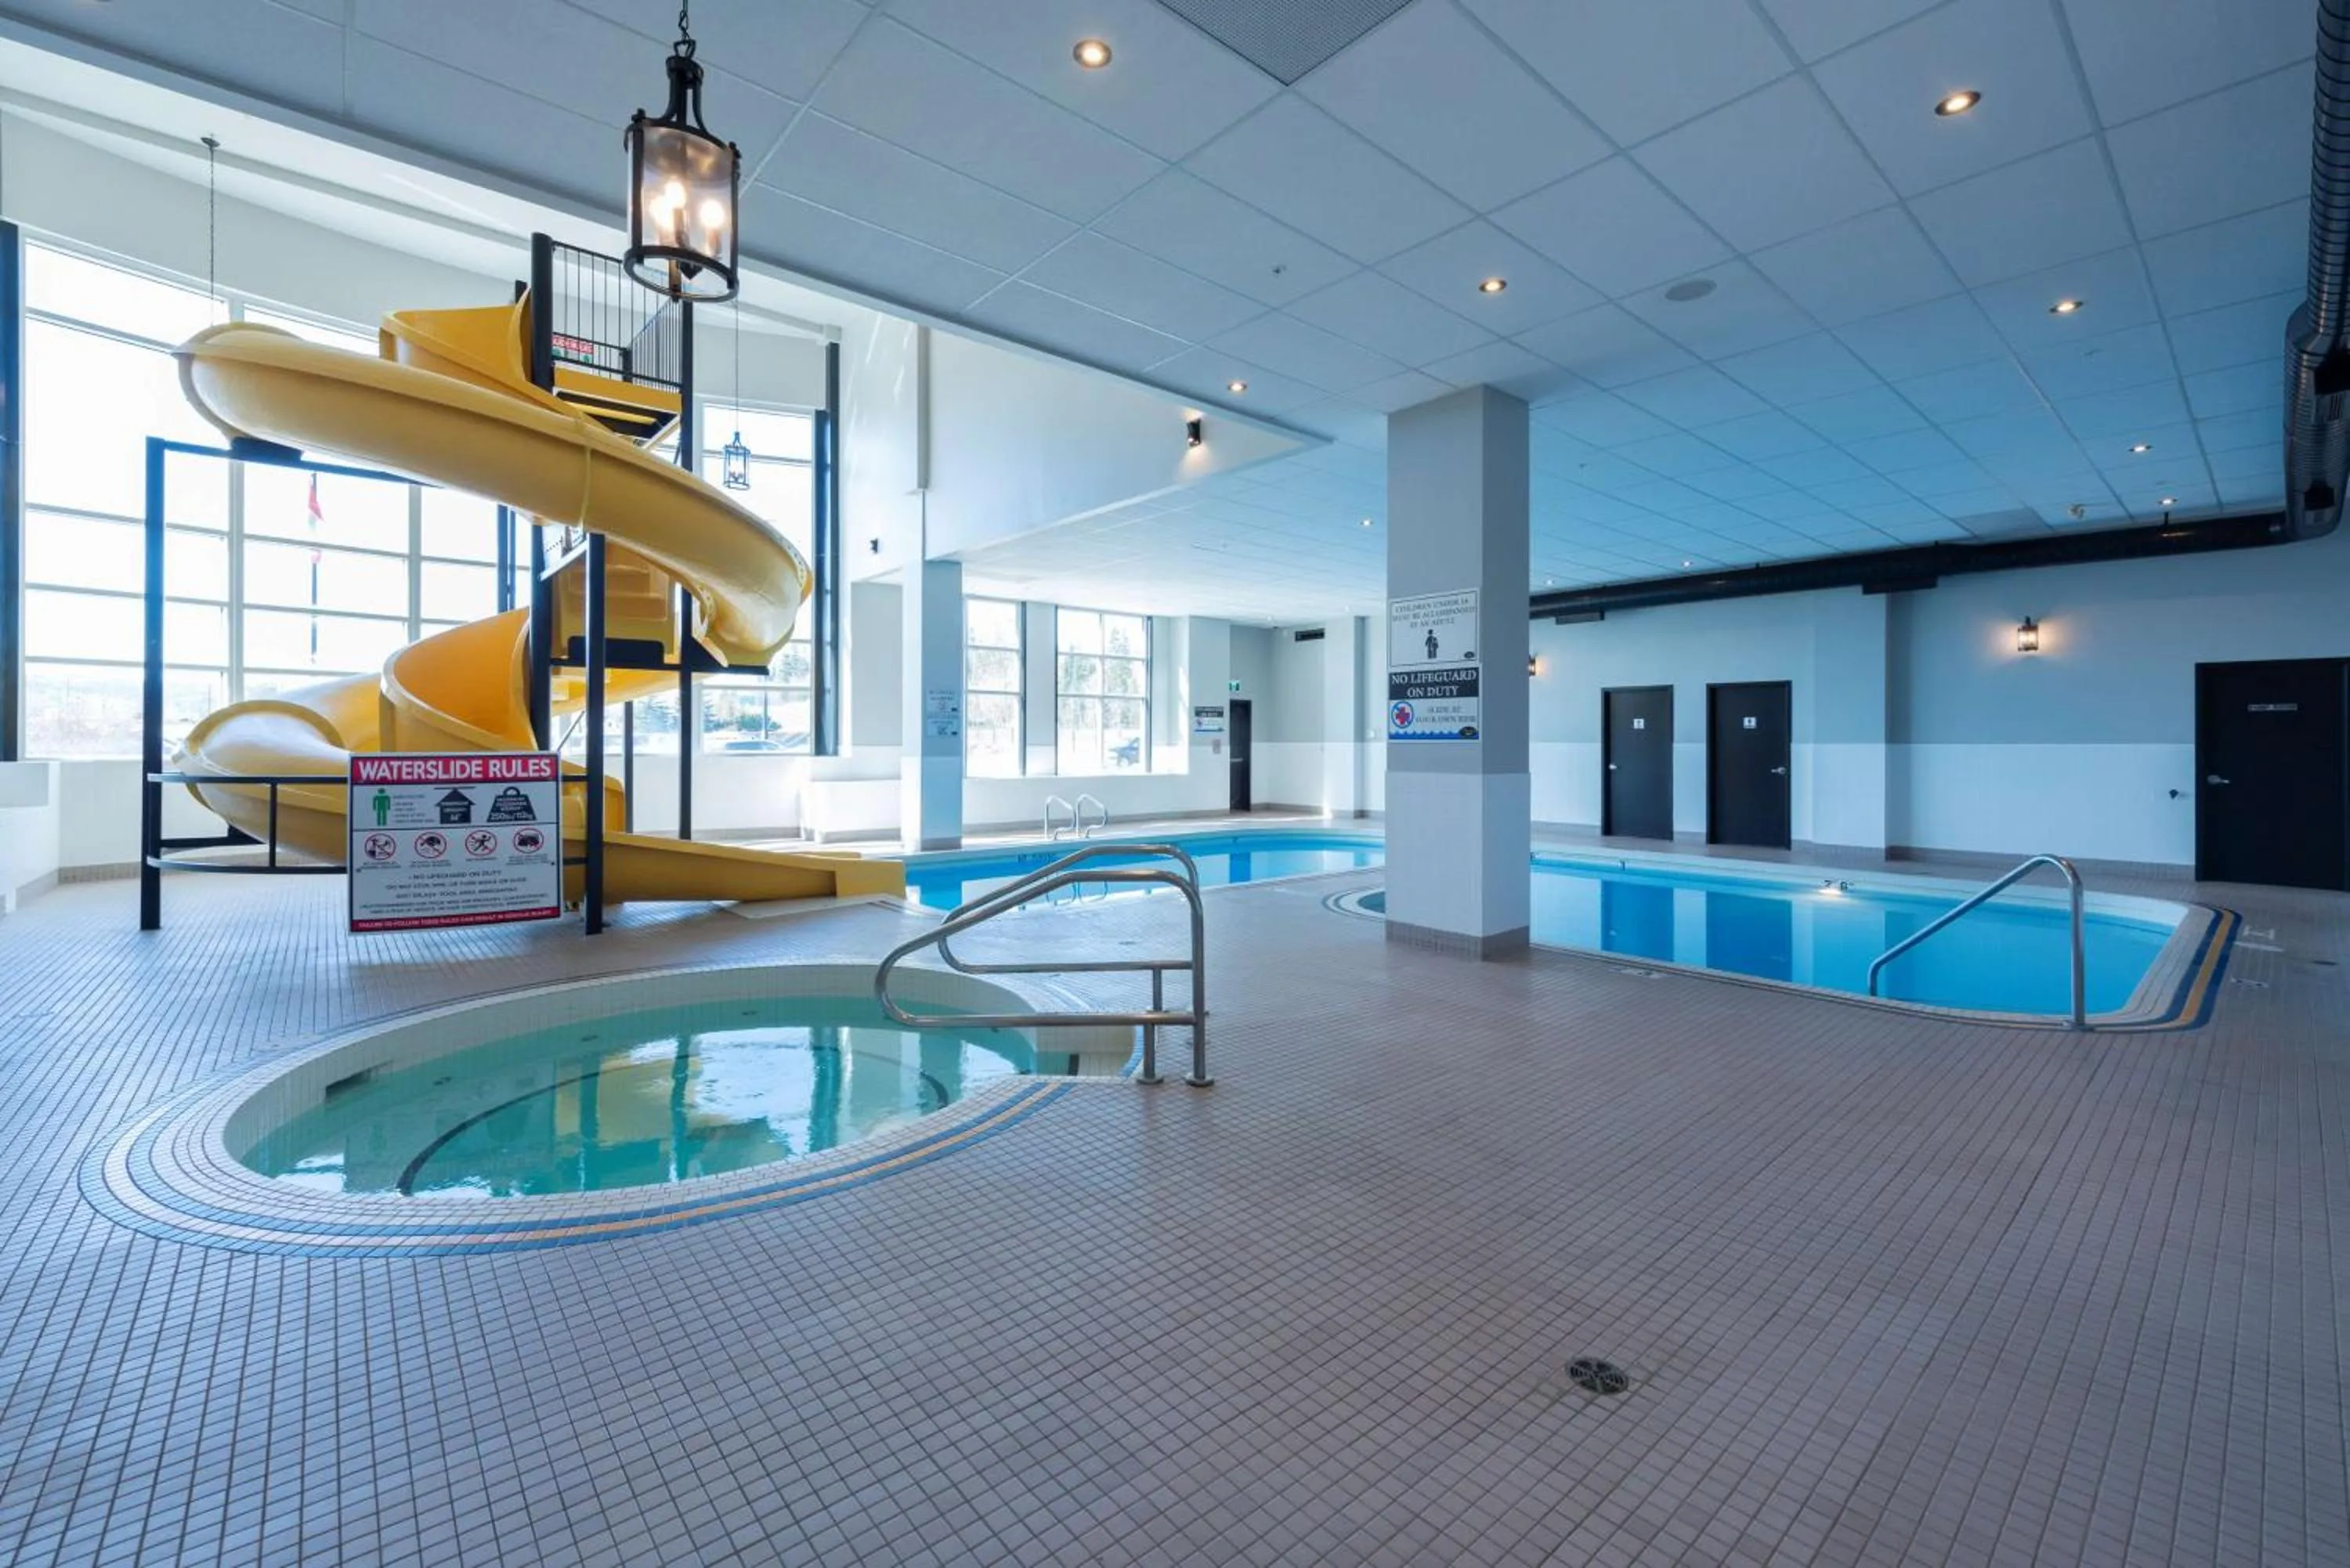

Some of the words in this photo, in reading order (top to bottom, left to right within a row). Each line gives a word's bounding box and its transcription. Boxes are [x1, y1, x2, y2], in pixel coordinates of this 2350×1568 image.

[1395, 602, 1432, 613] CHILDREN
[1391, 674, 1408, 685] NO
[1410, 670, 1477, 684] LIFEGUARD
[1406, 687, 1425, 698] ON
[1426, 686, 1459, 696] DUTY
[359, 761, 483, 779] WATERSLIDE
[489, 759, 551, 778] RULES
